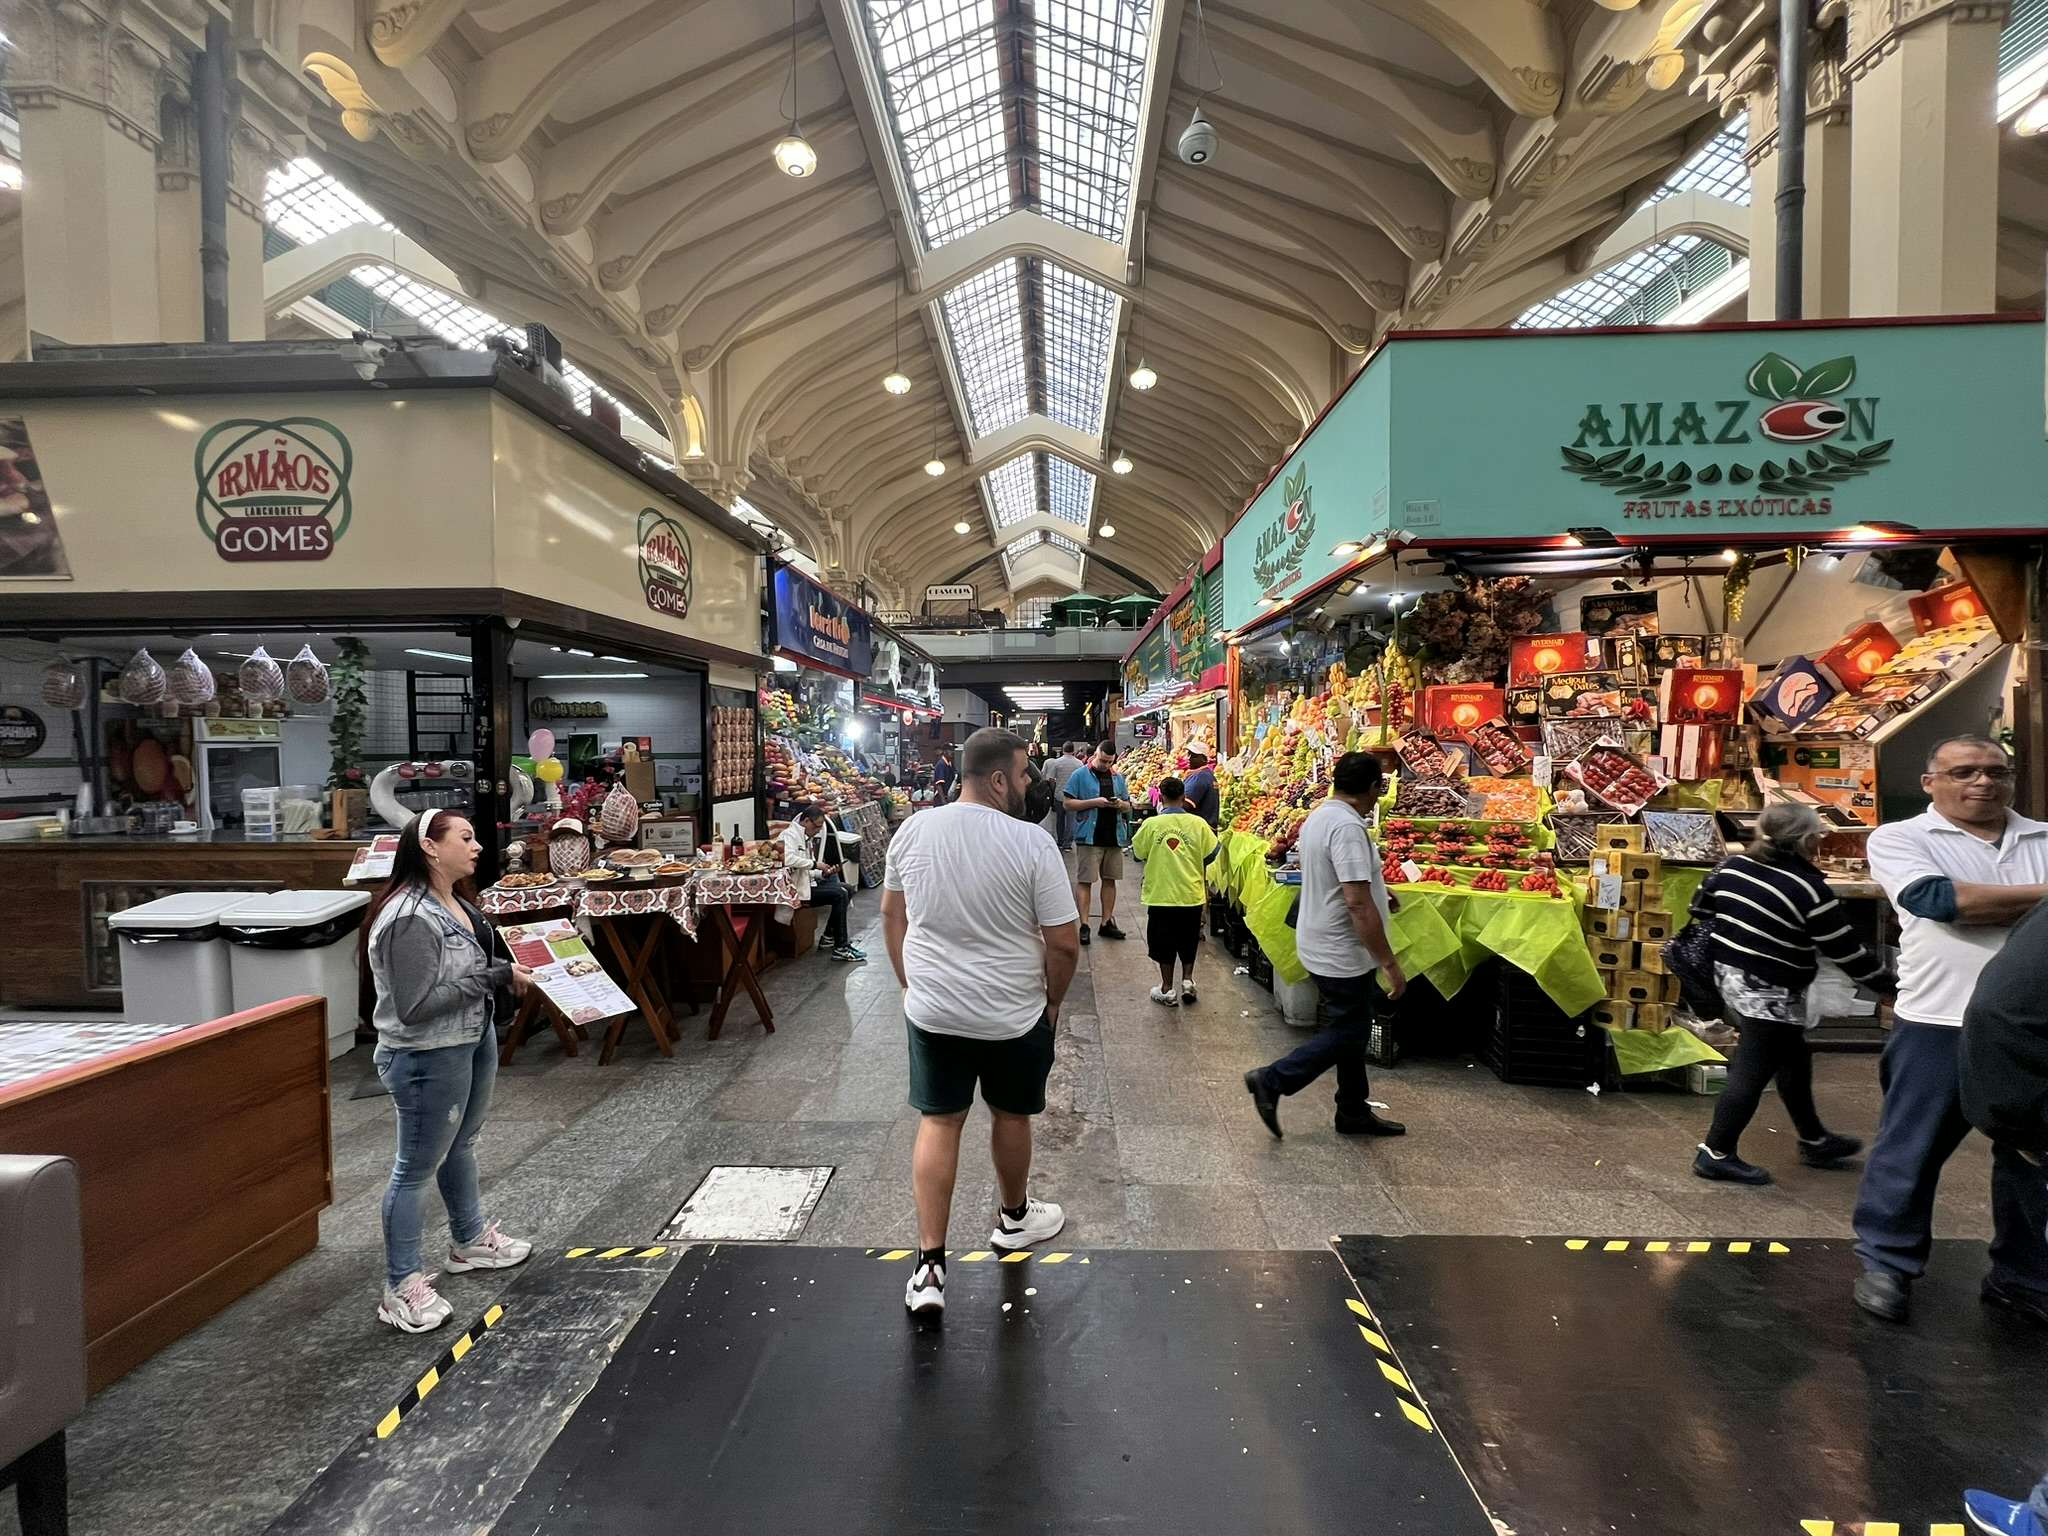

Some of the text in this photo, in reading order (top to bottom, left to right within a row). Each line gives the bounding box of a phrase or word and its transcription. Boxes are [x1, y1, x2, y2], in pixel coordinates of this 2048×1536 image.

[218, 438, 331, 499] IRMÃOS
[244, 506, 304, 517] LANCHONETE
[1623, 495, 1833, 519] FRUTAS EXÓTICAS
[220, 524, 330, 553] GOMES
[648, 584, 687, 614] GOMES
